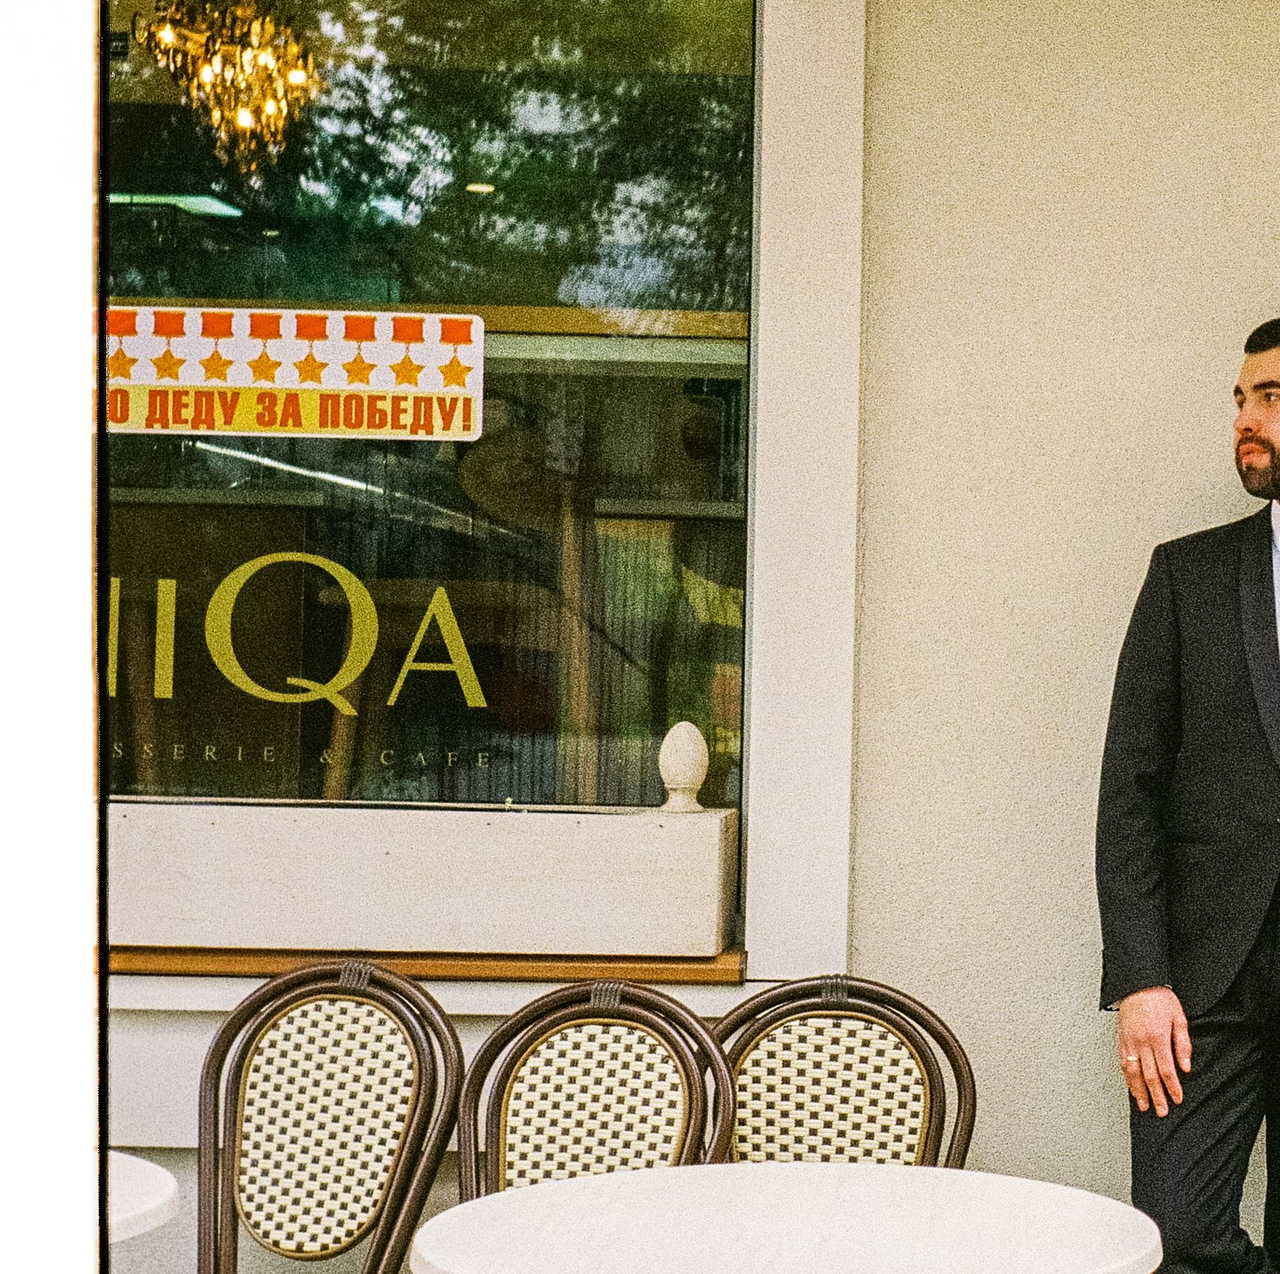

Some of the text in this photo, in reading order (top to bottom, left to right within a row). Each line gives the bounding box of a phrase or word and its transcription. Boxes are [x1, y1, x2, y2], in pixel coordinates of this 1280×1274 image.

[145, 389, 240, 430] ДЕДУ
[256, 392, 302, 427] ЗА
[319, 394, 472, 436] ПОБЕДУ!
[107, 550, 488, 716] IQA
[319, 748, 334, 764] &
[380, 749, 490, 768] CAFE
